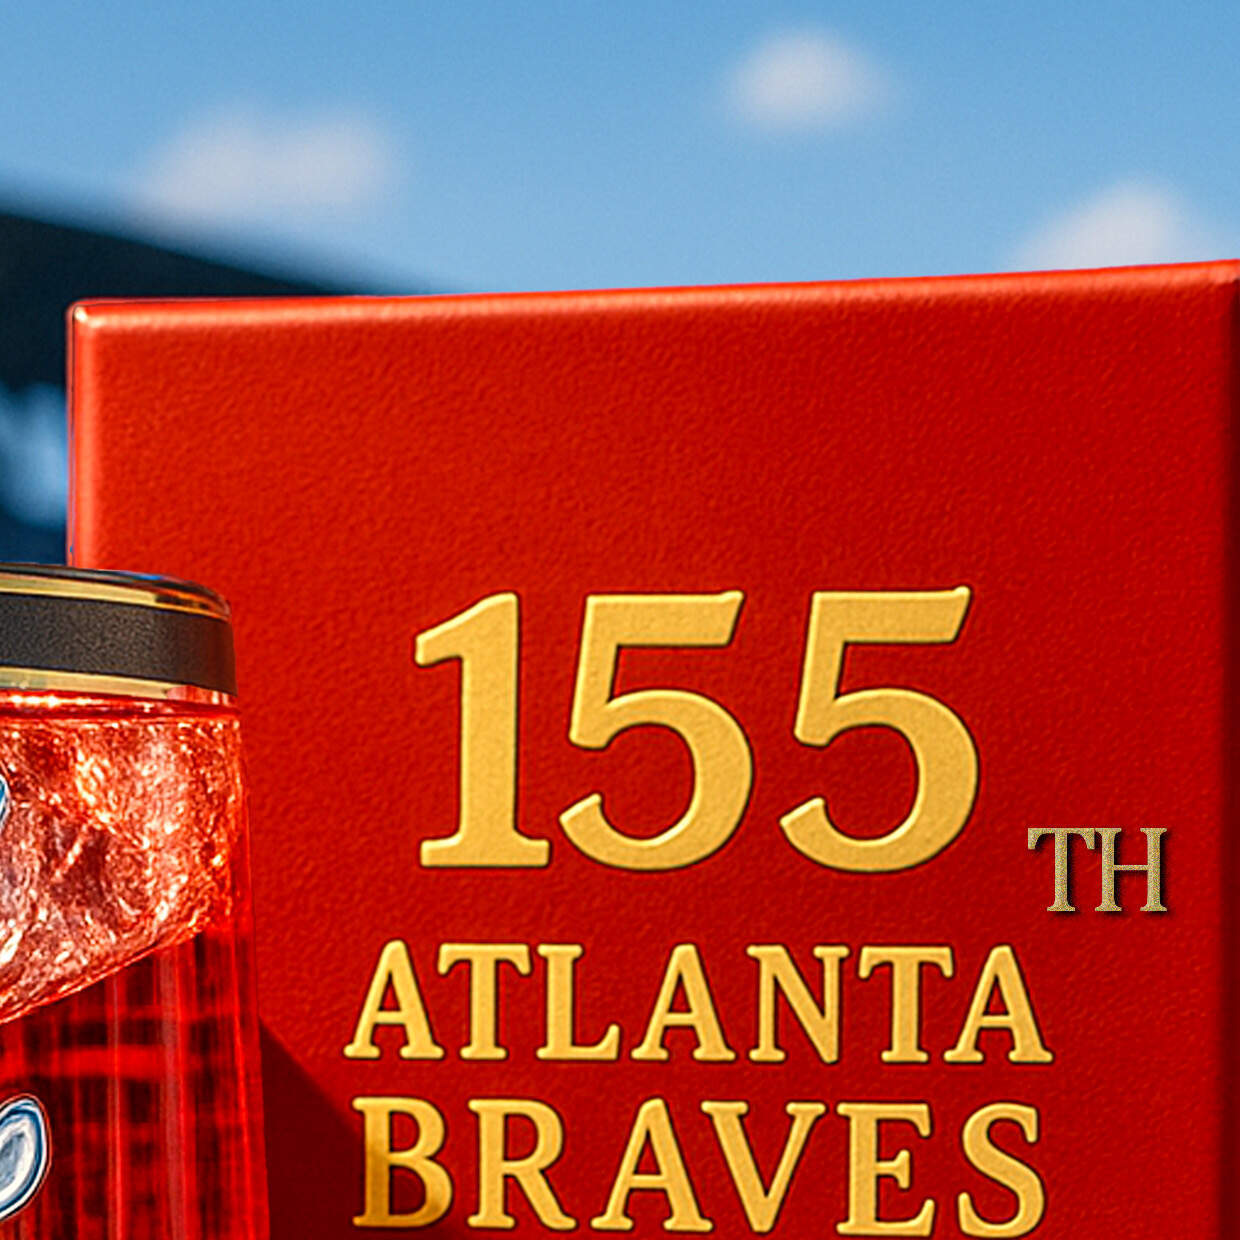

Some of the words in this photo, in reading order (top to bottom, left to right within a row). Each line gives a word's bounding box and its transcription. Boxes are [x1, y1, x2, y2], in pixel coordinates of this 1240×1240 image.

[414, 586, 981, 873] 155
[1026, 826, 1169, 914] TH
[344, 940, 1054, 1063] ATLANTA
[352, 1096, 1047, 1239] BRAVES
